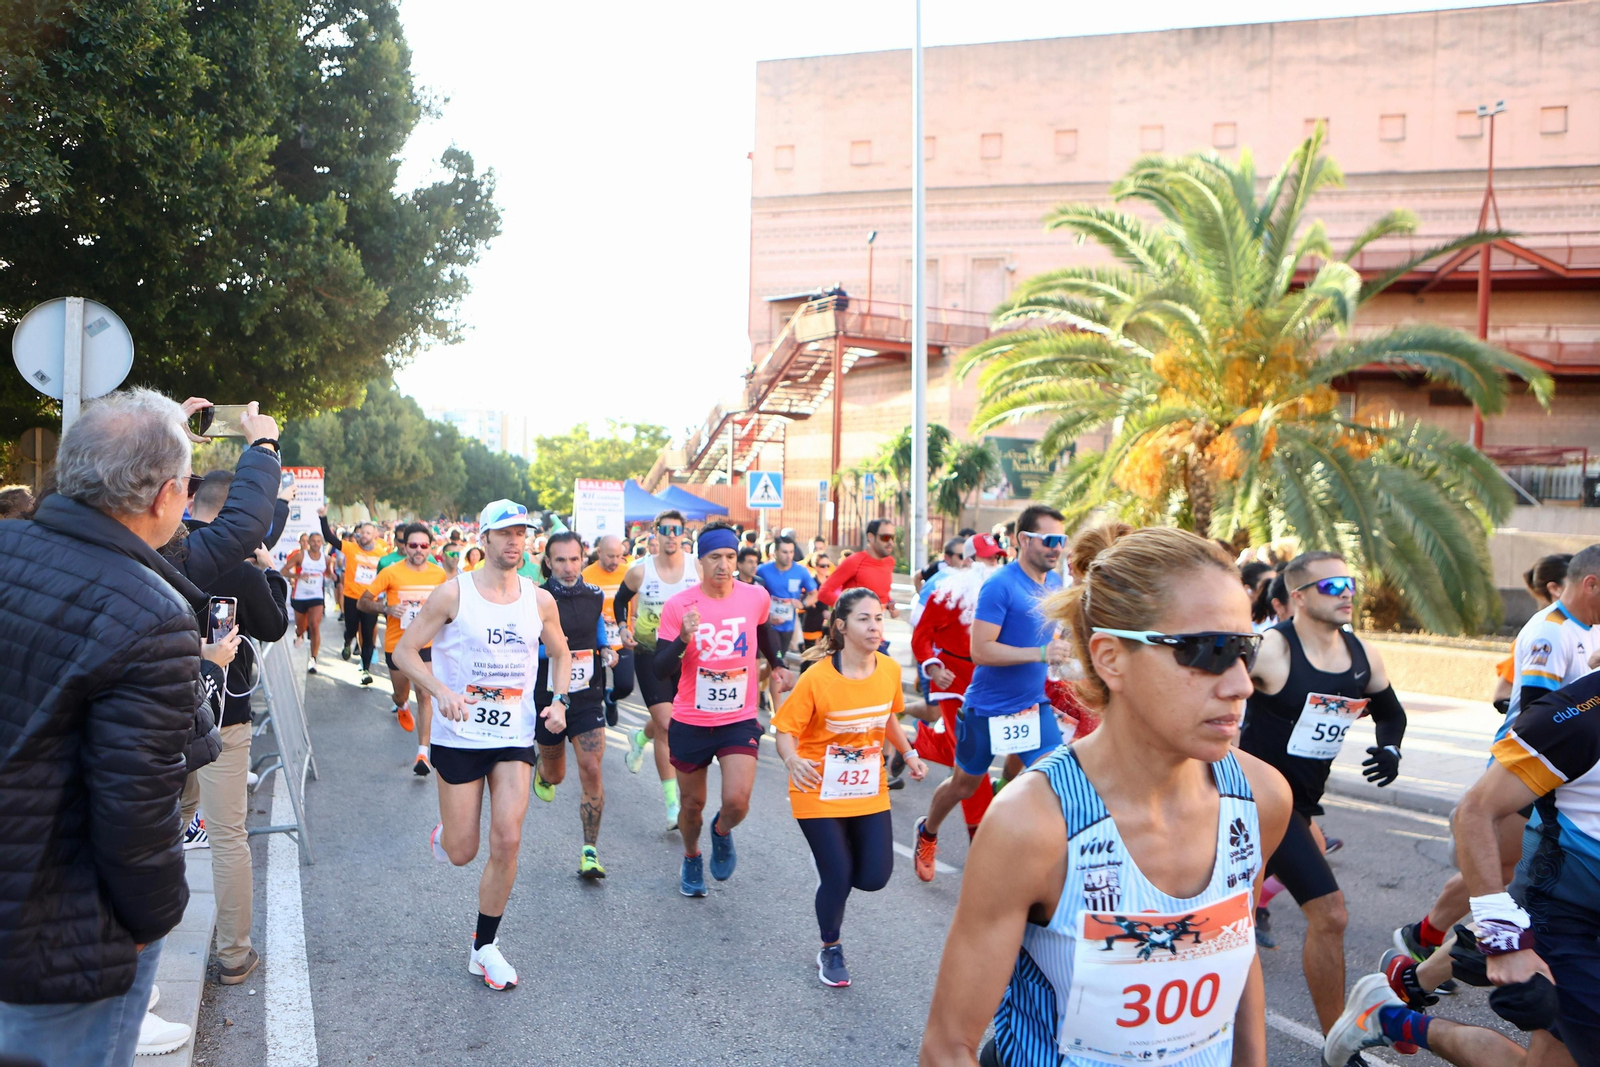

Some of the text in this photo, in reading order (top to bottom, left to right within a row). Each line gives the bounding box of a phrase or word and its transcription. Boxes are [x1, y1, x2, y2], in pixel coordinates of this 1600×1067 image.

[579, 480, 622, 490] SALIDA
[472, 669, 487, 677] Trofeo
[570, 668, 585, 680] 63
[707, 687, 737, 701] 354
[474, 707, 511, 727] 382
[1003, 724, 1029, 740] 339
[837, 769, 870, 786] 432
[1219, 916, 1249, 937] XII
[1116, 972, 1220, 1028] 300
